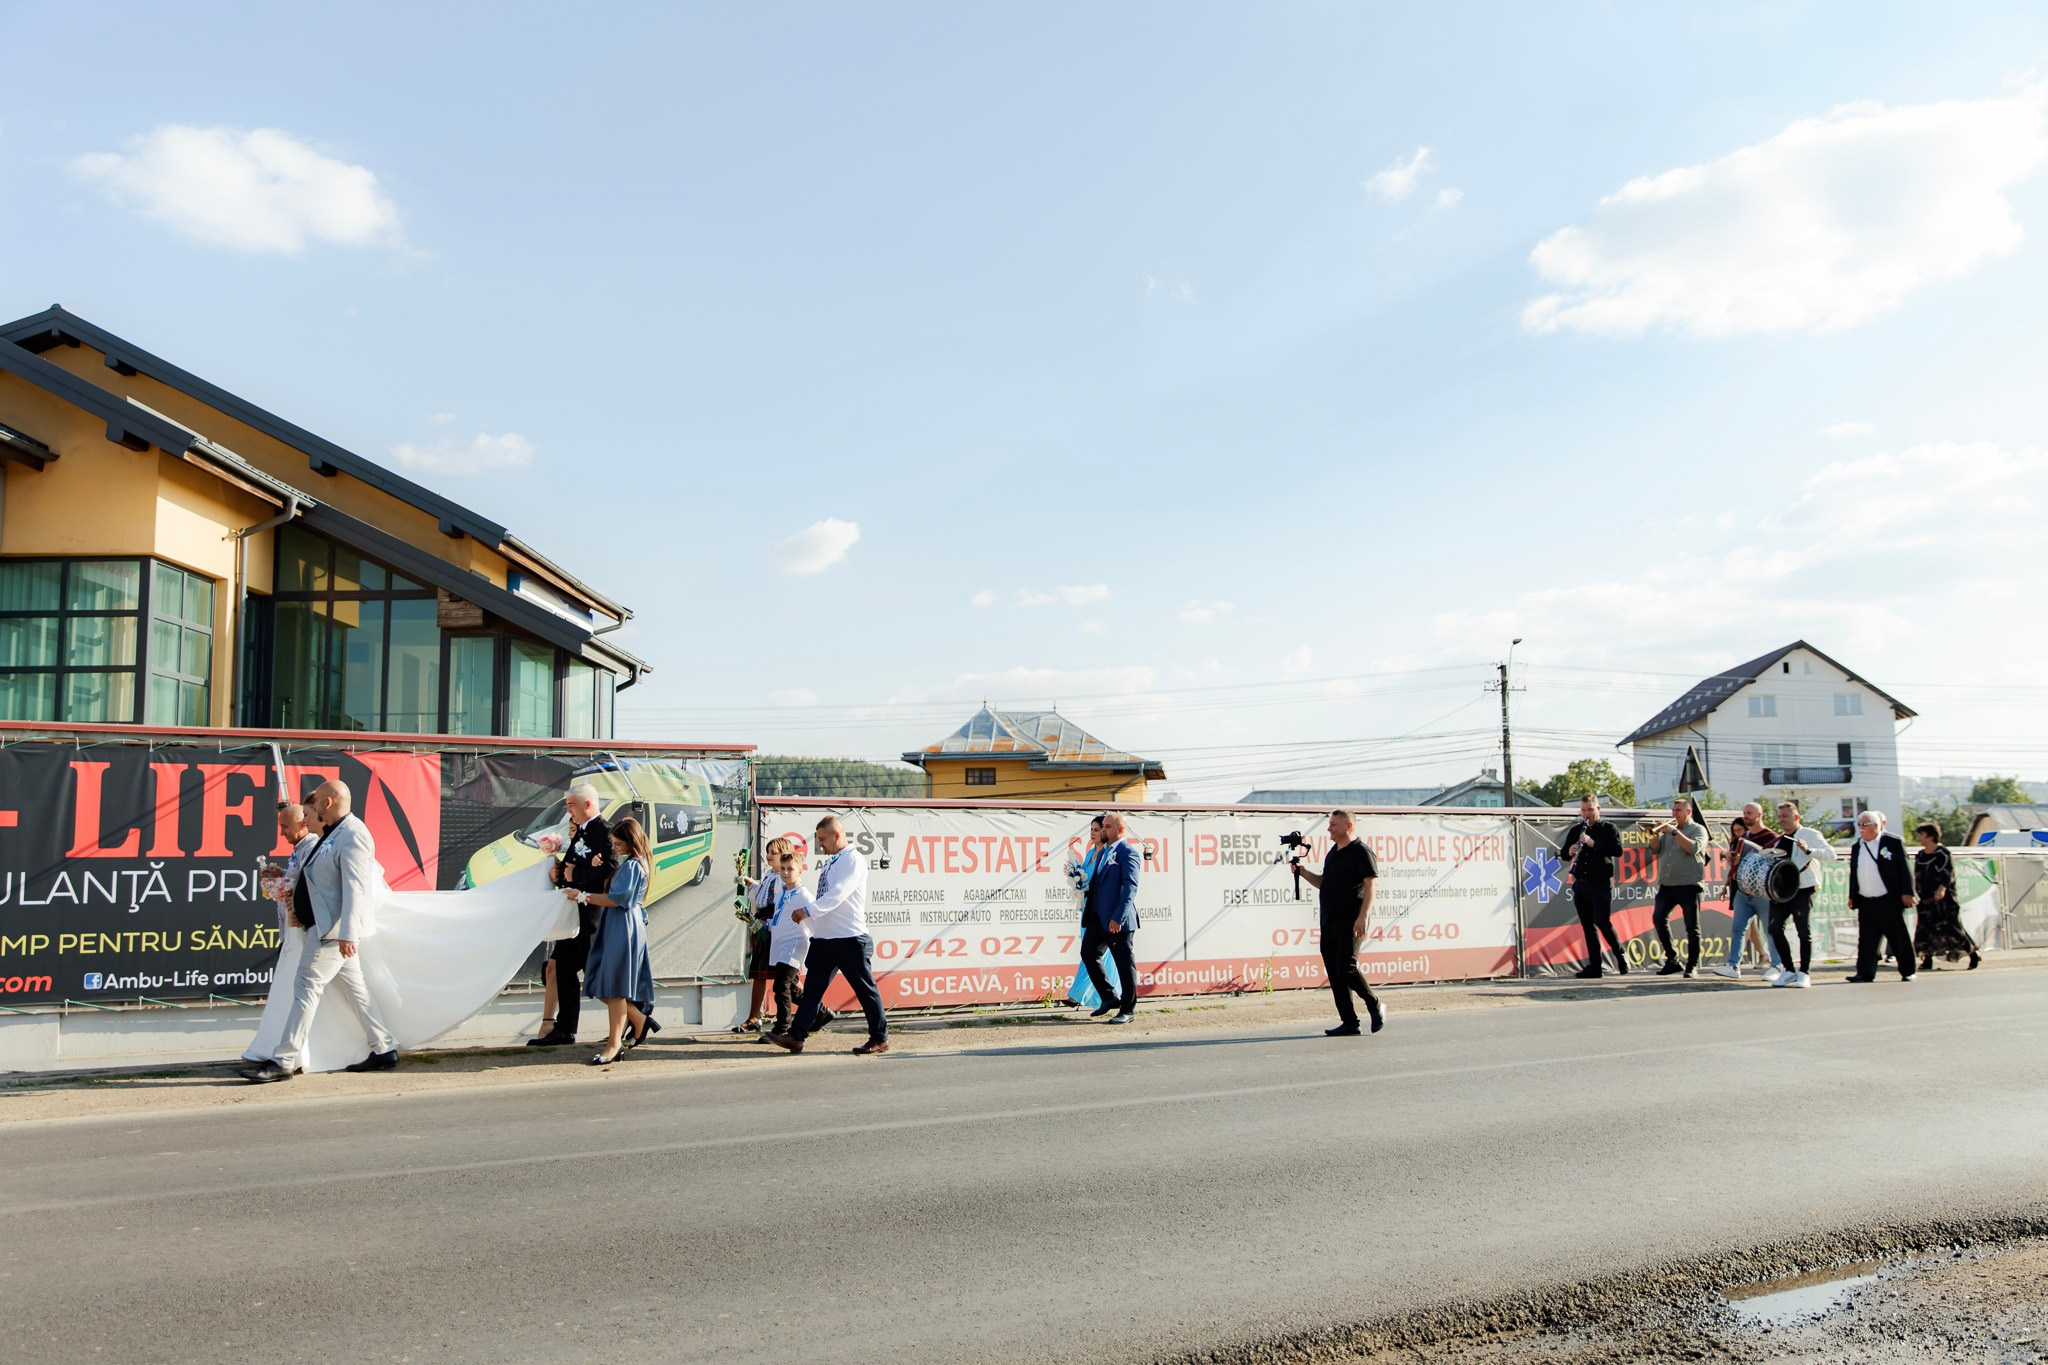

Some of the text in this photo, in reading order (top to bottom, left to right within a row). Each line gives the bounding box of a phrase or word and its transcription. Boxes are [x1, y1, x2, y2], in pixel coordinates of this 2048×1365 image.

[1220, 834, 1261, 849] BEST
[901, 836, 1051, 873] ATESTATE
[1391, 866, 1437, 880] Transporturilor
[903, 889, 945, 902] PERSOANE
[1010, 888, 1026, 901] TAXI
[1392, 889, 1408, 900] sau
[1410, 884, 1468, 902] preschimbare
[1470, 884, 1499, 899] permis
[1627, 886, 1643, 900] DE
[920, 909, 991, 923] INSTRUCTOR AUTO
[1000, 909, 1038, 921] PROFESOR
[1411, 922, 1460, 941] 640
[58, 930, 182, 956] PENTRU
[876, 938, 968, 960] 0742
[980, 935, 1045, 956] 027
[103, 968, 209, 990] Ambu-Life
[899, 973, 1009, 996] SUCEAVA,
[1015, 971, 1034, 990] în
[1242, 963, 1290, 984] (vis-a
[1294, 961, 1319, 978] vis
